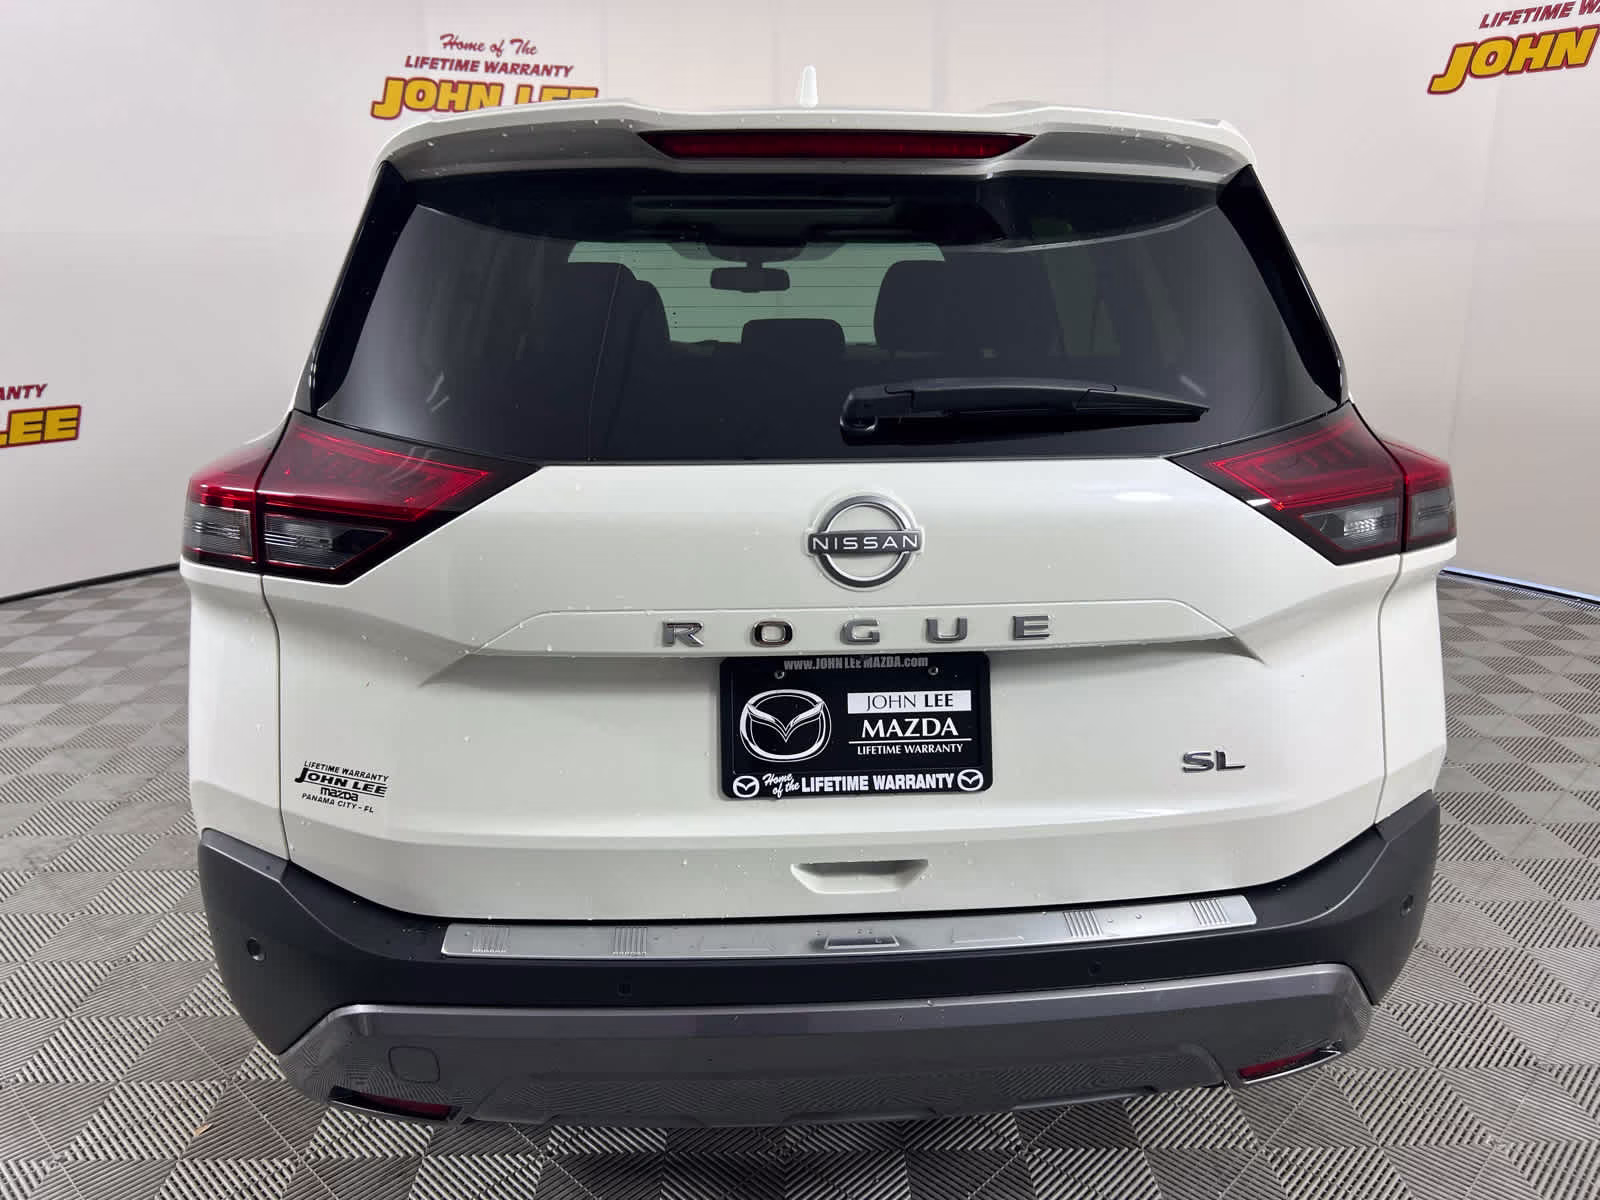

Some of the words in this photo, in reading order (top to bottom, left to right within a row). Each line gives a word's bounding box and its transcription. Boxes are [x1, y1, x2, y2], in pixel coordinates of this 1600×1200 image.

[1479, 1, 1576, 29] LIFETIME
[440, 33, 484, 52] Home
[490, 40, 505, 57] of
[510, 38, 538, 56] The
[405, 56, 480, 72] LIFETIME
[484, 61, 574, 78] WARRANTY
[1427, 24, 1600, 94] JOHN
[370, 76, 504, 120] JOHN
[812, 534, 919, 551] NISSAN
[662, 615, 1051, 648] ROGUE
[867, 694, 916, 711] JOHN
[924, 693, 953, 707] LEE
[861, 717, 959, 738] MAZDA
[857, 745, 901, 755] LIFETIME
[904, 743, 963, 753] WARRANTY
[304, 760, 340, 774] LIFETIME
[342, 768, 389, 782] WARRANTY
[1182, 750, 1246, 773] SL
[294, 767, 348, 787] JOHN
[352, 781, 387, 795] LEE
[762, 773, 793, 787] Home
[772, 786, 784, 799] of
[785, 781, 800, 793] the
[801, 776, 869, 793] LIFETIME
[872, 773, 955, 790] WARRANTY
[302, 793, 335, 806] PANAMA
[337, 800, 357, 810] CITY
[364, 805, 374, 814] FL
[320, 787, 359, 802] mazda
